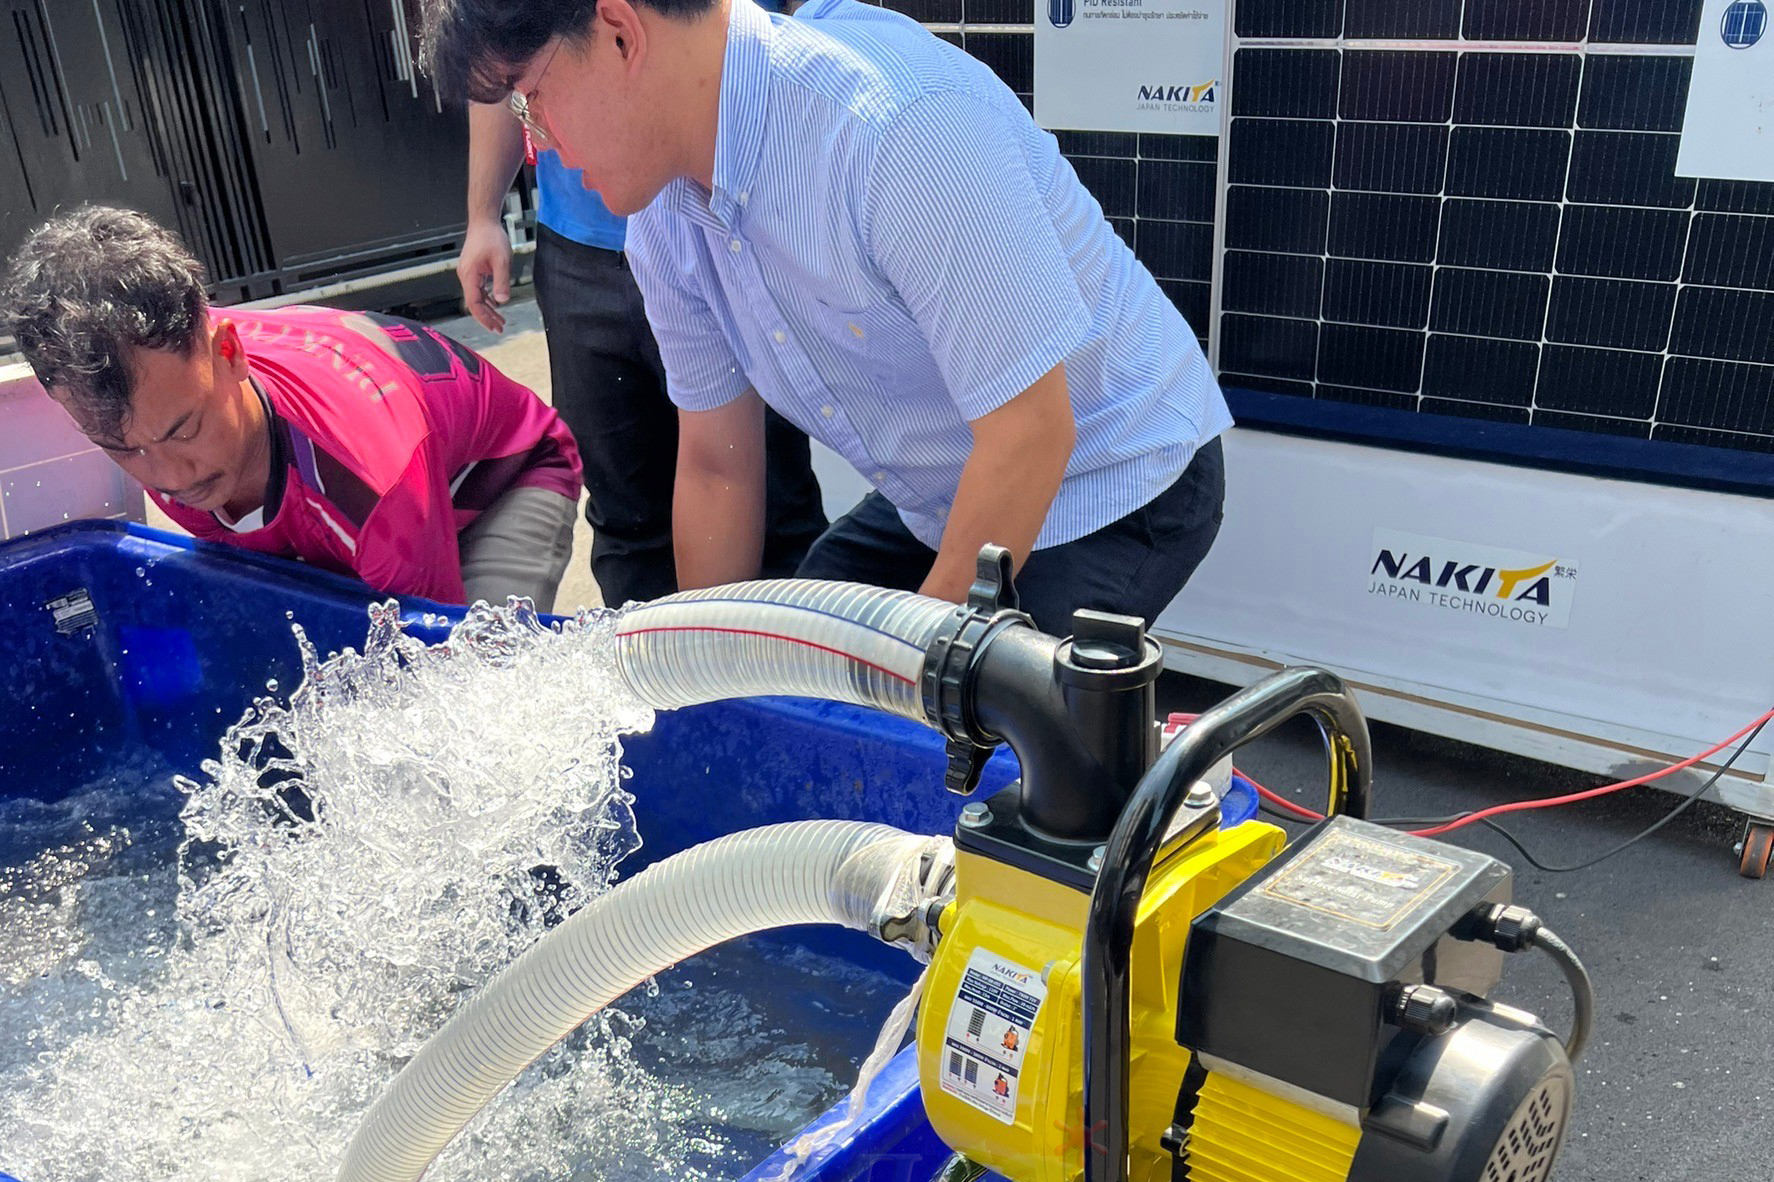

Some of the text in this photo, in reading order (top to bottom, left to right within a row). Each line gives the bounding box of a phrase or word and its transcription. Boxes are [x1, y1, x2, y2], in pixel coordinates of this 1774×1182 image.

[1137, 78, 1216, 103] NAKITA
[1136, 103, 1215, 113] JAPAN TECHNOLOGY
[1370, 549, 1559, 607] NAKITA
[1368, 582, 1548, 625] JAPAN TECHNOLOGY
